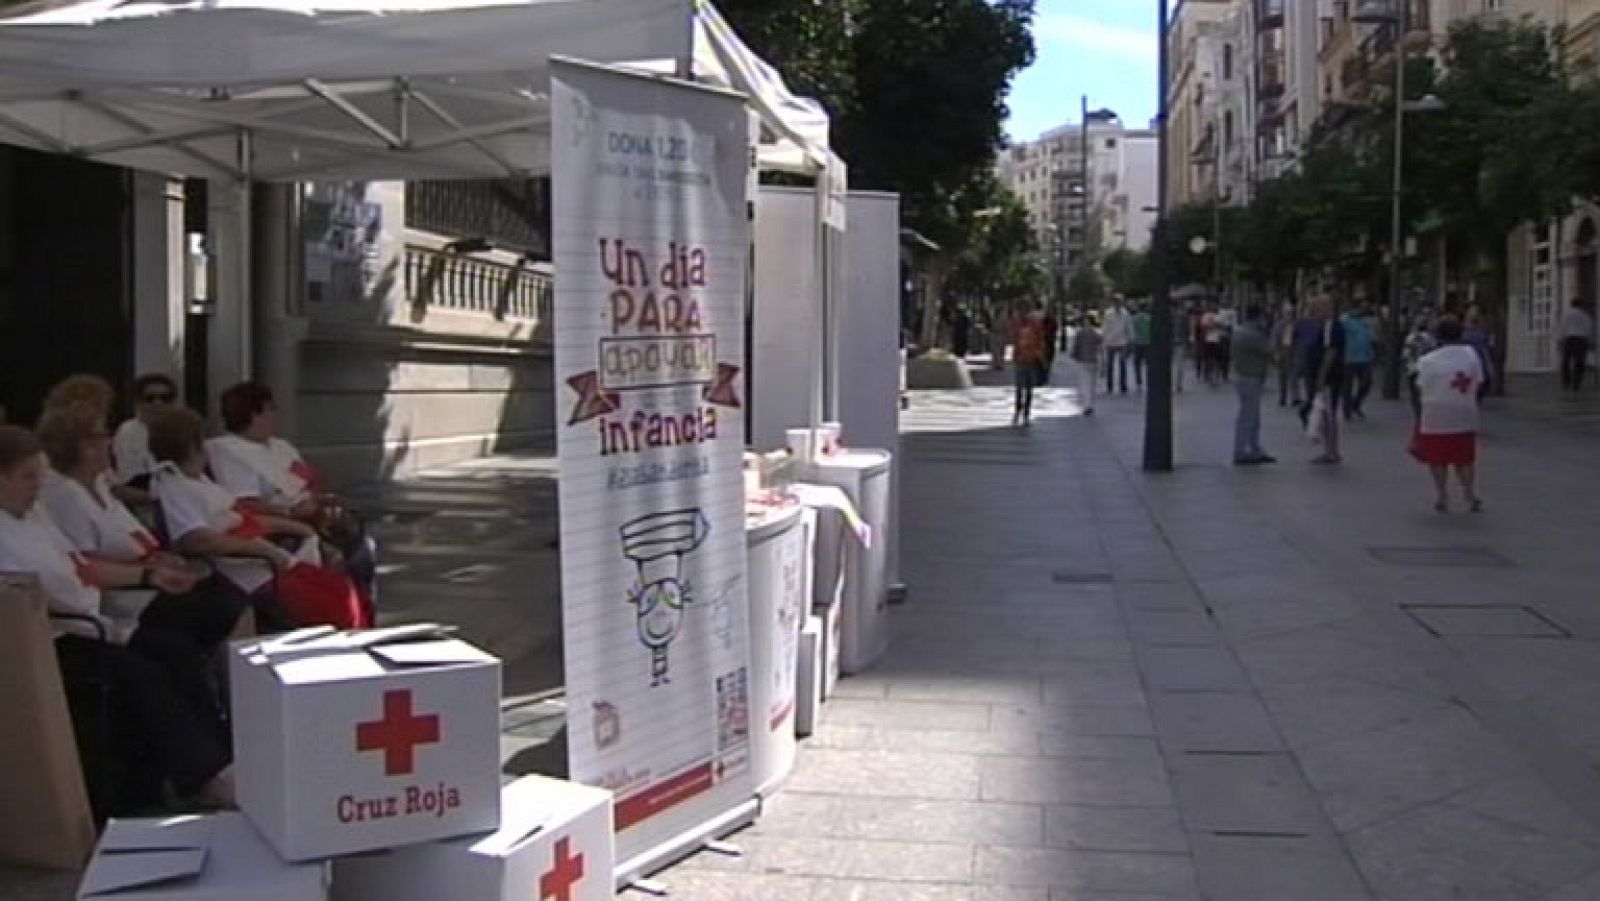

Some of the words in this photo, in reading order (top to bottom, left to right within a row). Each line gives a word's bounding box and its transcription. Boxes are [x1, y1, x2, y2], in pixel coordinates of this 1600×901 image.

[608, 131, 653, 155] DONA
[598, 238, 649, 287] Un
[610, 289, 702, 334] PARA
[599, 407, 718, 456] infancia
[337, 794, 398, 823] Cruz
[405, 781, 461, 817] Roja
